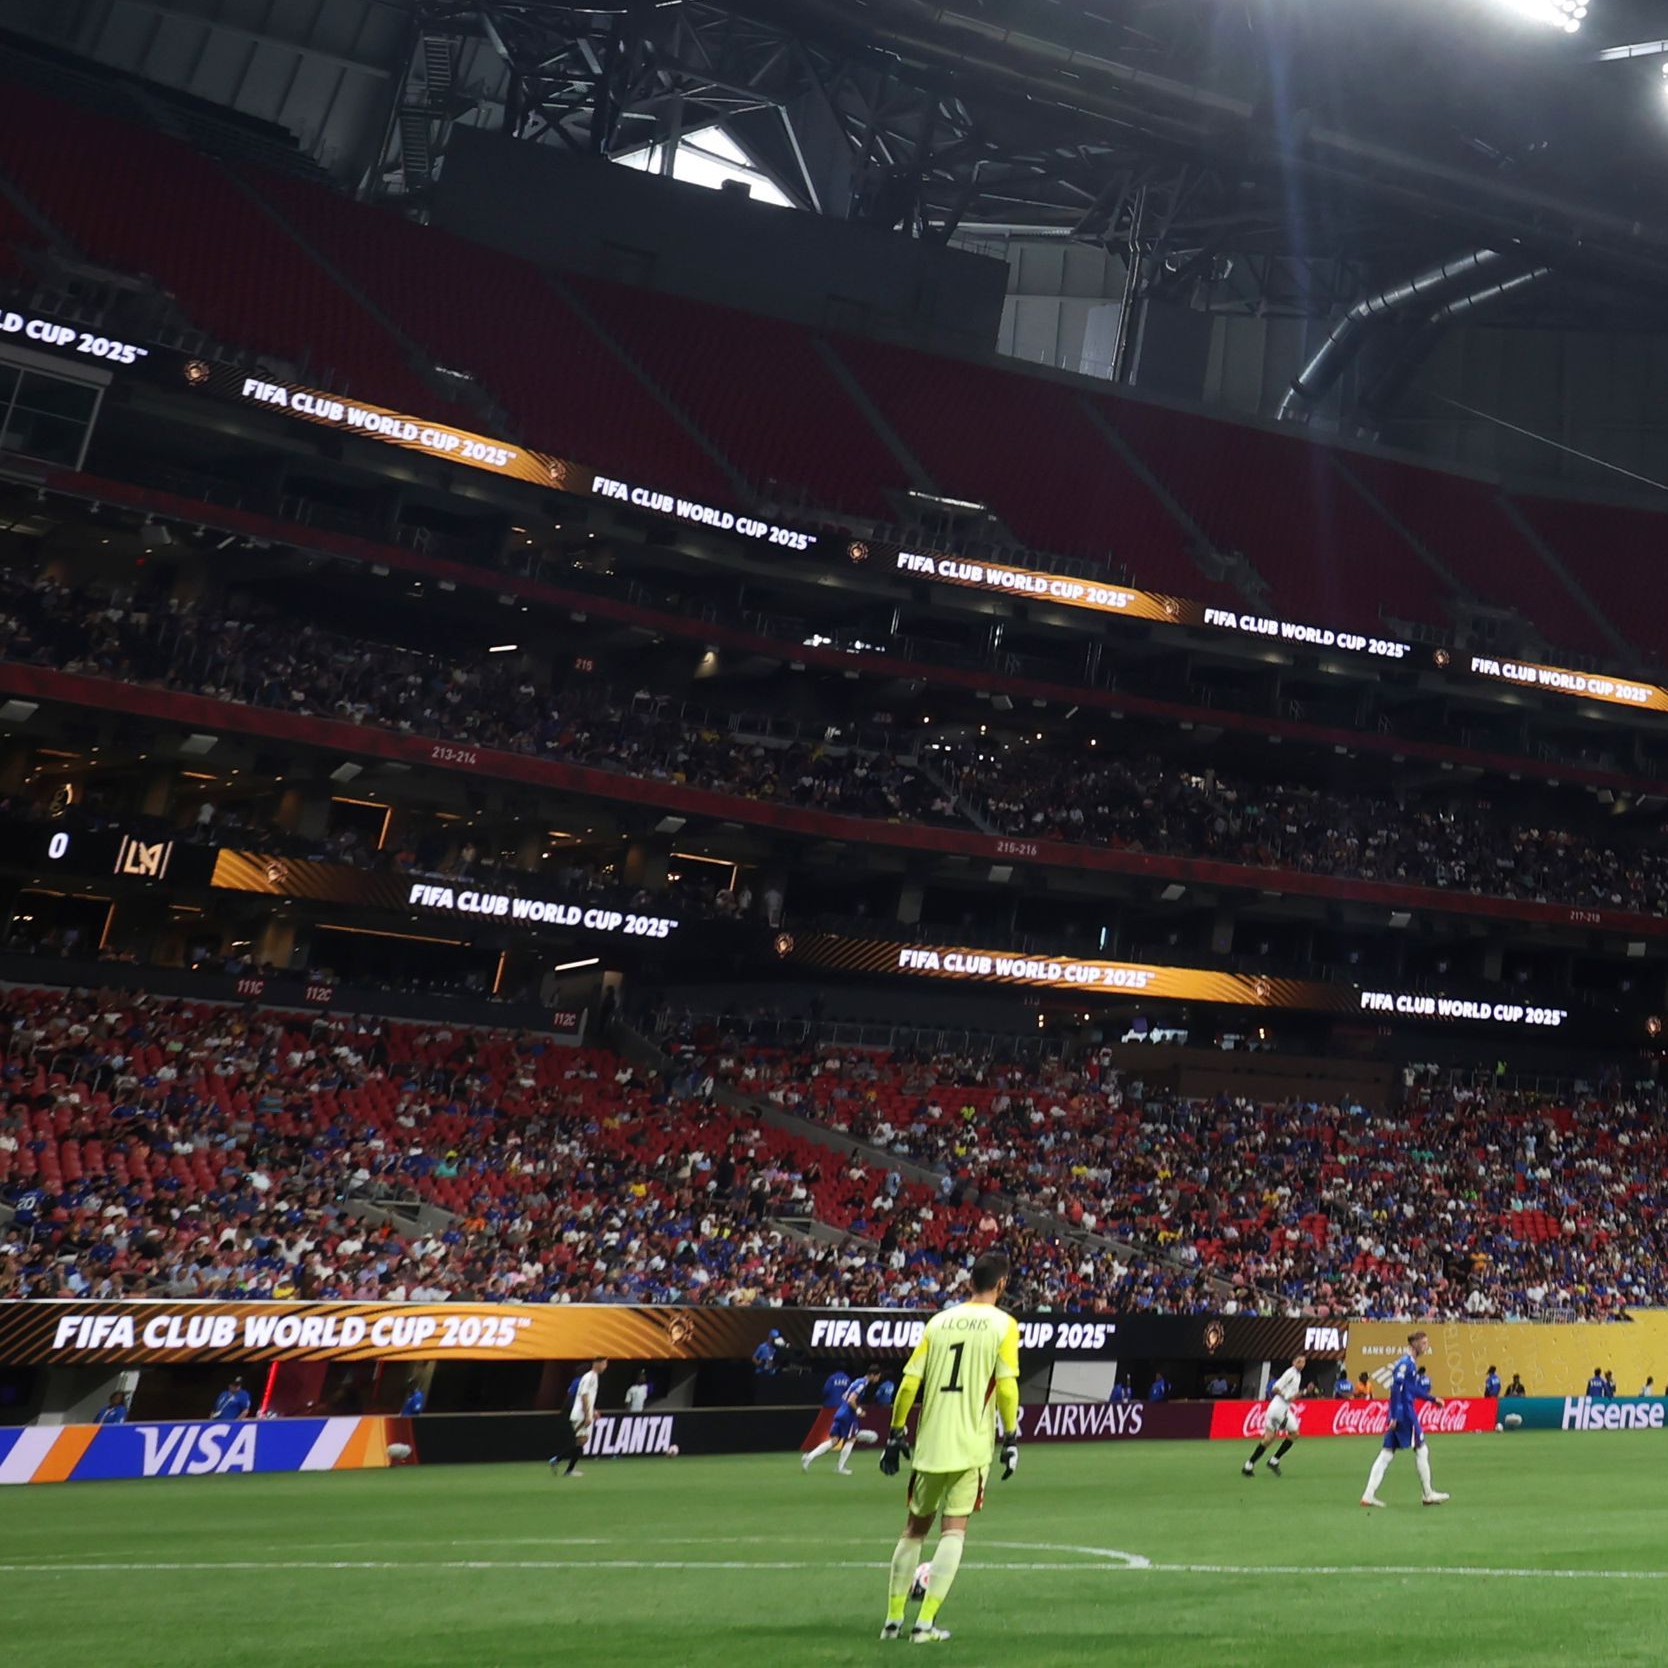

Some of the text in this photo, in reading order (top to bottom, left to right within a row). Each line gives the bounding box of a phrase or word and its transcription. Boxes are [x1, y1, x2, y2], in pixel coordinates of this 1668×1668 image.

[25, 319, 76, 346] CUP
[242, 378, 287, 407] FIFA
[291, 392, 345, 421] CLUB
[347, 407, 421, 441] WORLD
[419, 428, 461, 452] CUP
[591, 475, 629, 502] FIFA
[630, 487, 675, 513] CLUB
[676, 499, 735, 530] WORLD
[735, 517, 768, 539] CUP
[897, 552, 935, 574] FIFA
[938, 560, 984, 582] CLUB
[986, 568, 1049, 594] WORLD
[1050, 580, 1084, 600] CUP
[1203, 608, 1237, 629] FIFA
[1239, 615, 1279, 636] CLUB
[1281, 622, 1335, 646] WORLD
[1336, 632, 1367, 651] CUP
[1471, 657, 1501, 676] FIFA
[1502, 663, 1537, 682] CLUB
[1538, 669, 1587, 691] WORLD
[1587, 677, 1614, 696] CUP
[432, 745, 477, 765] 213-214
[409, 883, 454, 909] FIFA
[456, 890, 510, 916] CLUB
[512, 898, 583, 926] WORLD
[583, 908, 623, 931] CUP
[899, 949, 940, 970] FIFA
[943, 953, 992, 974] CLUB
[995, 958, 1062, 980] WORLD
[1063, 964, 1101, 984] CUP
[237, 979, 264, 995] 111C
[305, 985, 332, 1002] 112C
[553, 1011, 576, 1027] 112C
[1360, 992, 1394, 1011] FIFA
[1396, 995, 1436, 1014] CLUB
[1437, 999, 1492, 1019] WORLD
[1493, 1004, 1524, 1022] CUP
[52, 1315, 136, 1349] FIFA
[142, 1315, 238, 1348] CLUB
[244, 1315, 366, 1348] WORLD
[370, 1315, 436, 1348] CUP
[811, 1319, 925, 1349] FIFA CLUB
[941, 1318, 989, 1332] LLORIS
[1016, 1323, 1054, 1349] CUP
[1304, 1326, 1341, 1351] FIFA
[940, 1340, 965, 1393] 1
[1362, 1345, 1384, 1356] BANK
[1386, 1345, 1396, 1356] OF
[1034, 1403, 1144, 1437] AIRWAYS
[1561, 1395, 1665, 1431] Hisense
[135, 1423, 257, 1477] VISA
